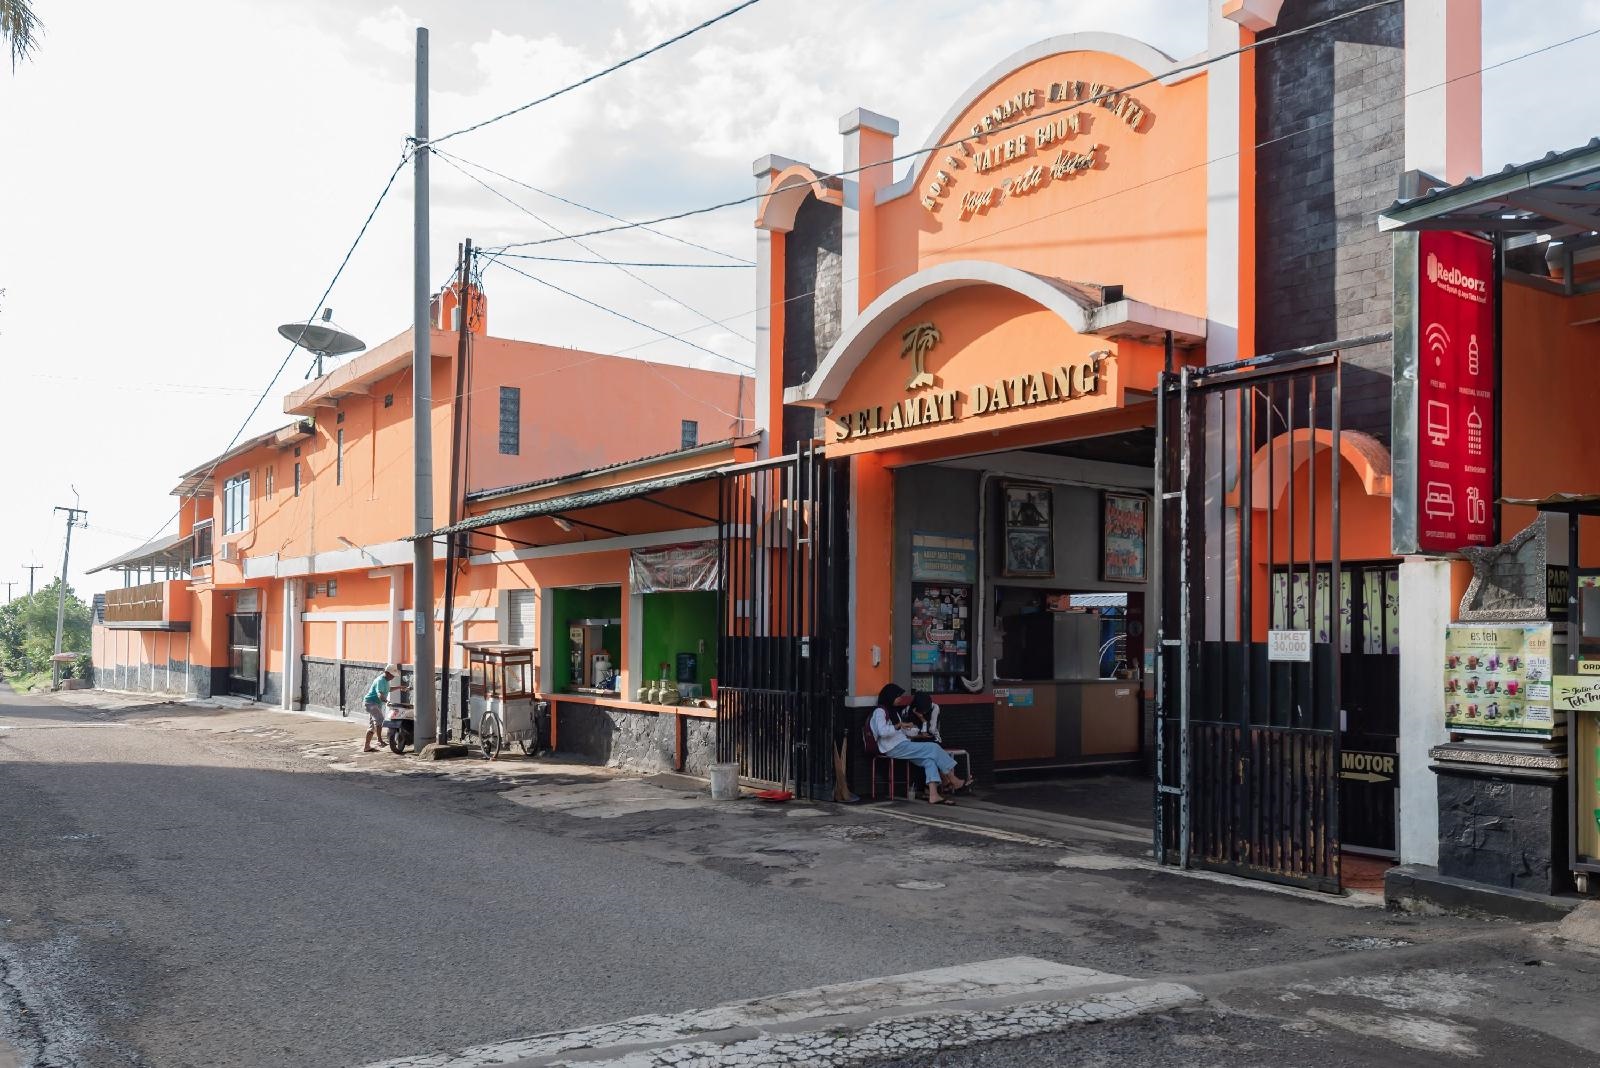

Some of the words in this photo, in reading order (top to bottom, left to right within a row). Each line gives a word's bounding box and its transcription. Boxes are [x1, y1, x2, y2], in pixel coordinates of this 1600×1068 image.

[973, 134, 1028, 173] WATER
[1437, 262, 1486, 293] RedDoorz
[836, 390, 958, 441] SELAMAT
[972, 361, 1101, 417] DATANG
[1548, 587, 1569, 604] MOT
[1273, 632, 1306, 641] TIKET
[1470, 632, 1481, 641] es
[1482, 630, 1498, 641] teh
[1562, 695, 1585, 709] Teh
[1341, 753, 1395, 773] MOTOR
